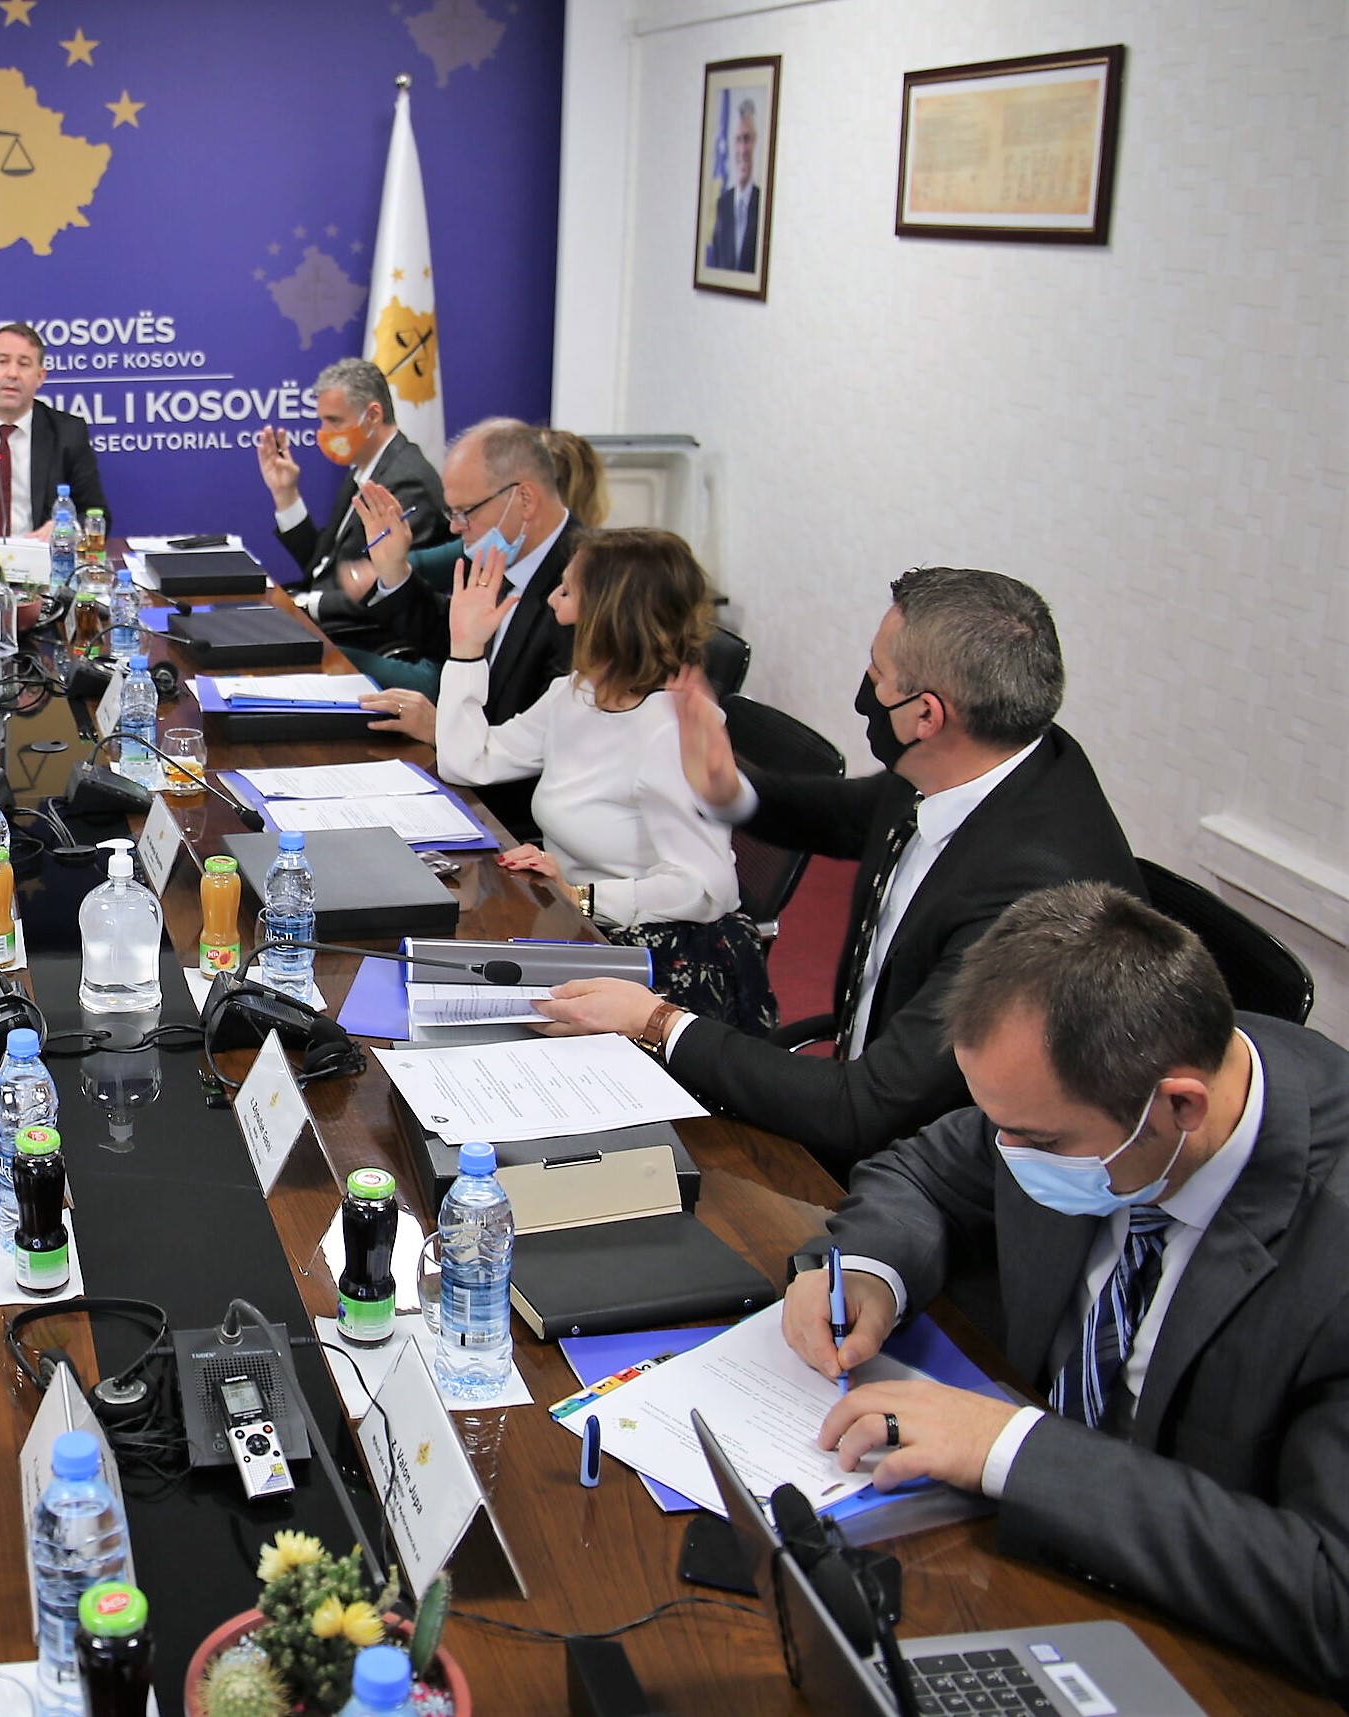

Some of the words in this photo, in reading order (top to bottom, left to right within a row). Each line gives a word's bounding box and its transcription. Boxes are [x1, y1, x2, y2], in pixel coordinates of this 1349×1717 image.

[27, 311, 176, 346] KOSOVËS
[43, 353, 88, 371] BLIC
[92, 353, 119, 370] OF
[123, 351, 206, 369] KOSOVO
[124, 391, 135, 424] I
[146, 381, 319, 423] KOSOVËS
[89, 431, 233, 453] SECUTORIAL
[396, 1447, 411, 1485] Valon
[409, 1484, 424, 1515] Jupa
